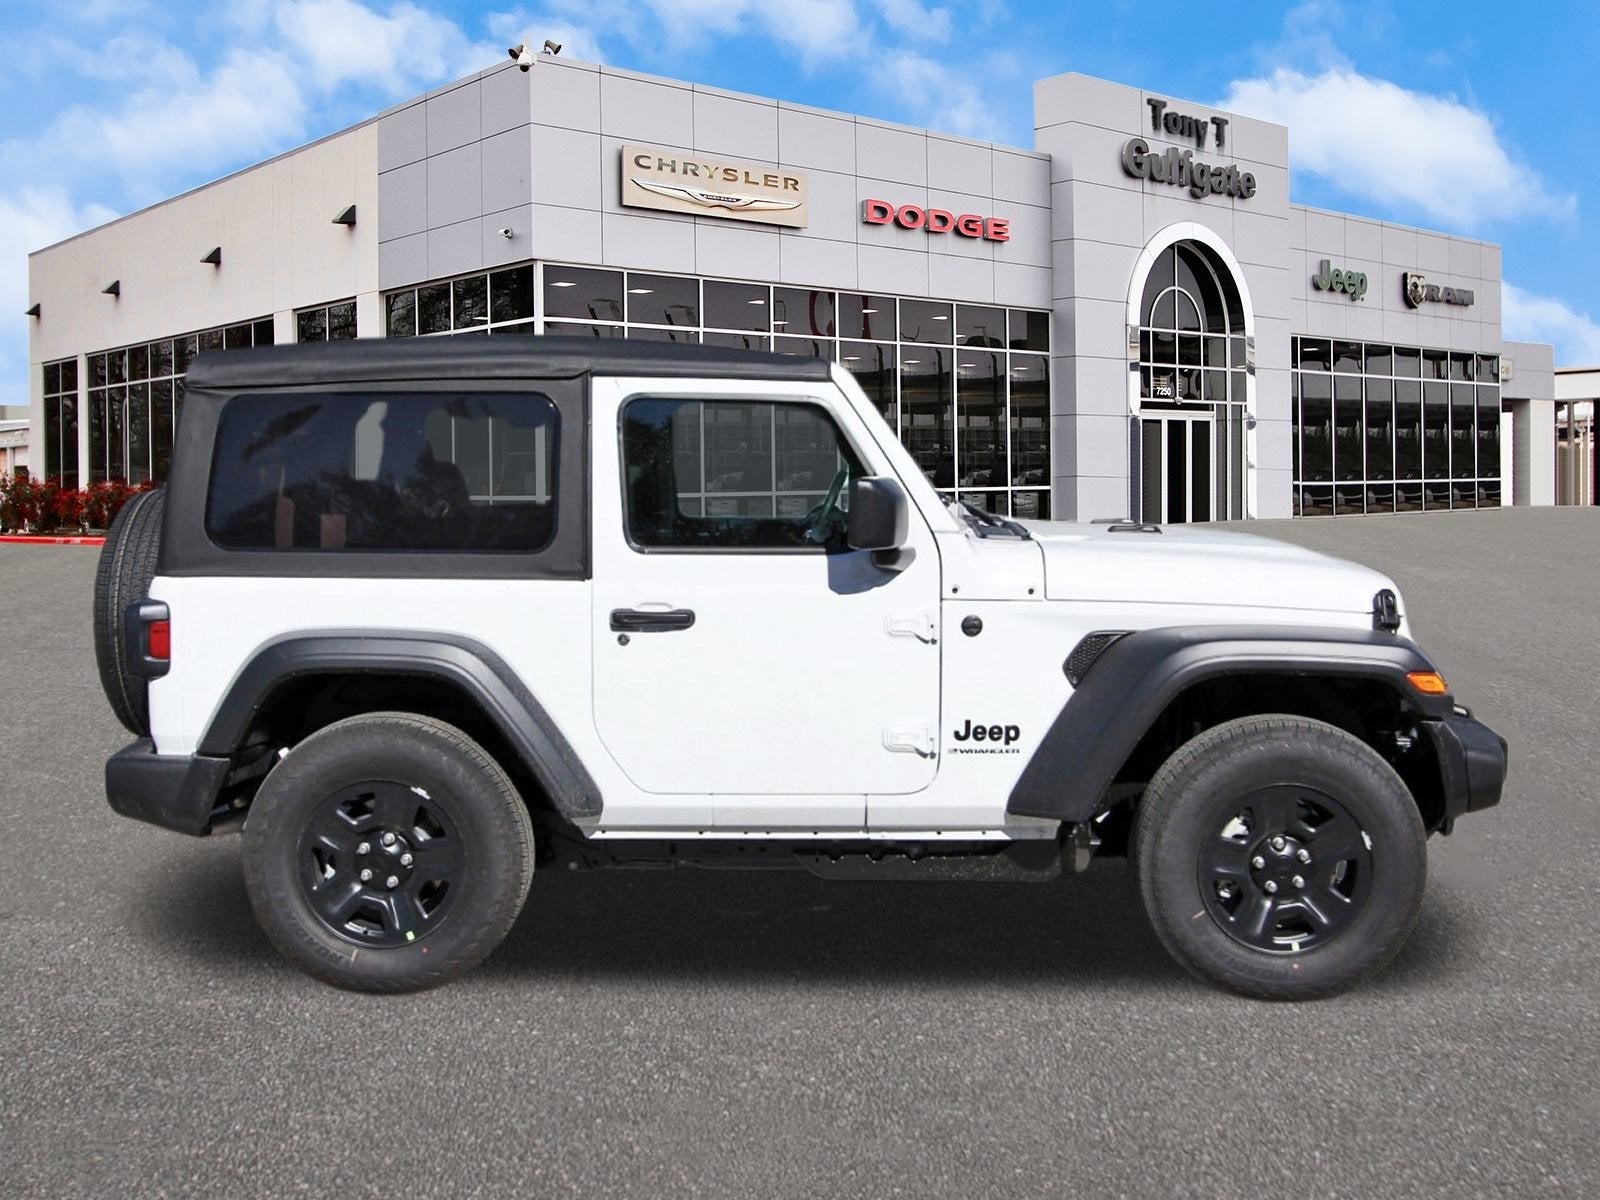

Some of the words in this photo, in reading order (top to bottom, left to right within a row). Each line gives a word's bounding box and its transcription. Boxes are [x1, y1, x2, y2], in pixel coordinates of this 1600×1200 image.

[1146, 98, 1208, 147] Tony
[1210, 116, 1229, 147] T
[634, 154, 800, 191] CHRYSLER
[1121, 138, 1256, 198] Gulfgate
[862, 199, 1010, 242] DODGE
[1313, 259, 1368, 300] Jeep
[1424, 284, 1474, 306] RAM
[1156, 387, 1172, 396] 7250
[954, 719, 1020, 746] Jeep
